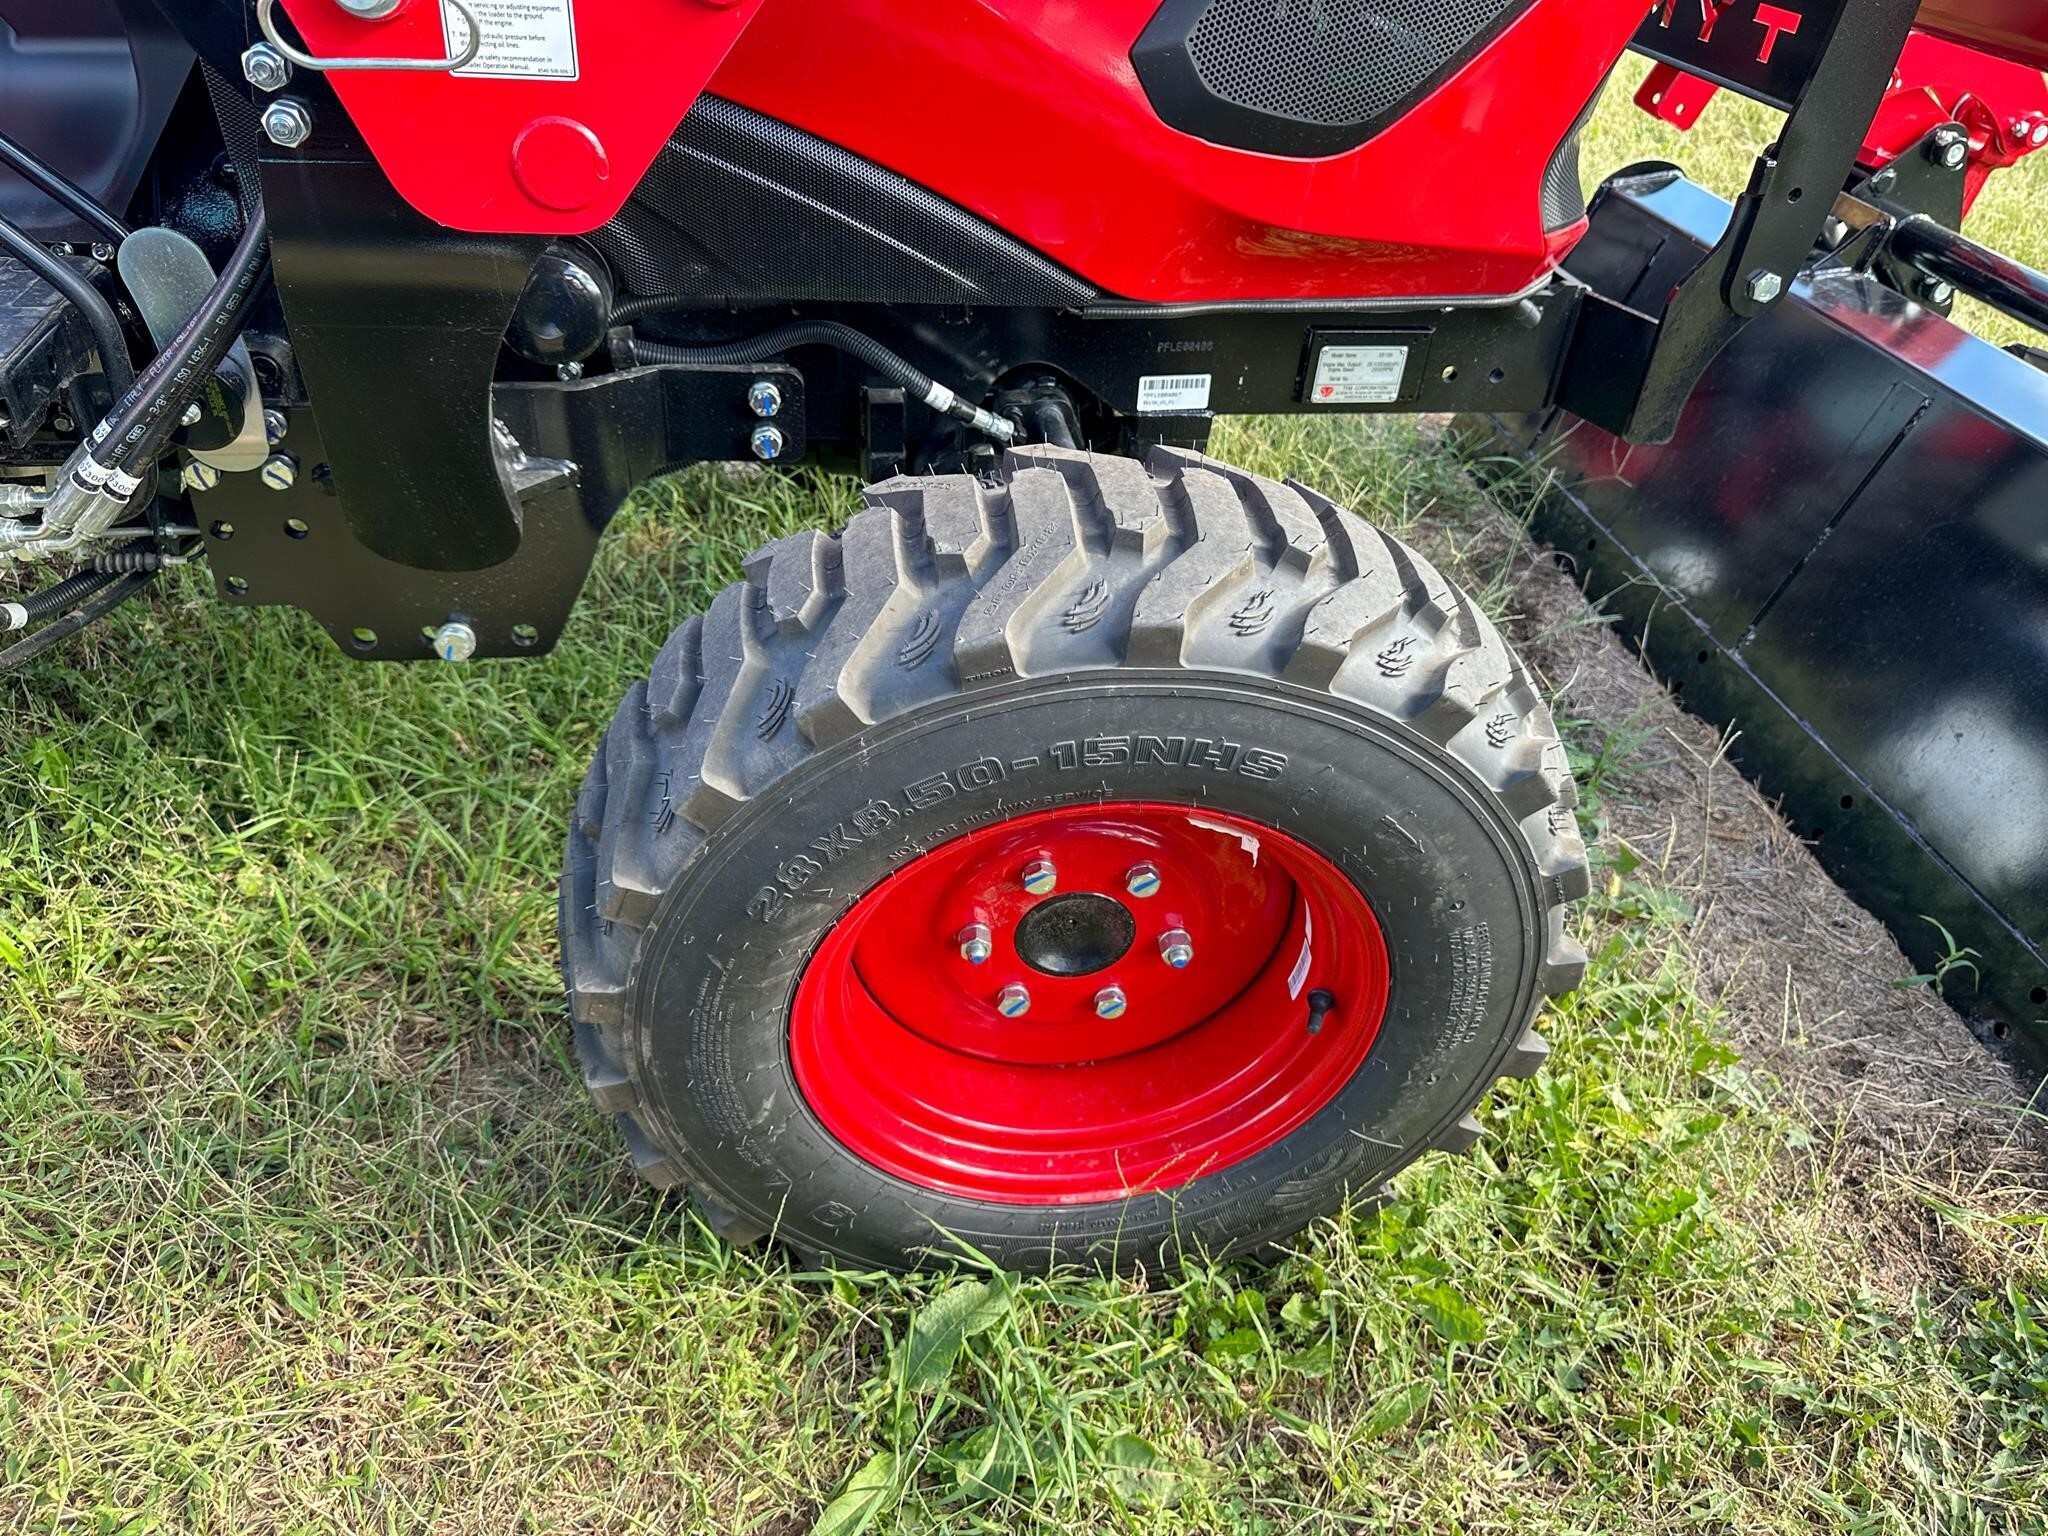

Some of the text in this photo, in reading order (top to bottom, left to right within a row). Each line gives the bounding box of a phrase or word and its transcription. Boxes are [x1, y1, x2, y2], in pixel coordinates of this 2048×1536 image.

[506, 4, 530, 12] adjusting
[173, 367, 191, 383] ISO
[188, 337, 214, 365] 1436-1
[216, 312, 231, 325] EN
[226, 293, 242, 311] 853
[248, 257, 260, 272] DN
[124, 384, 144, 407] ITALY
[888, 787, 1114, 861] NOT FOR HIGHWAY SERVICE
